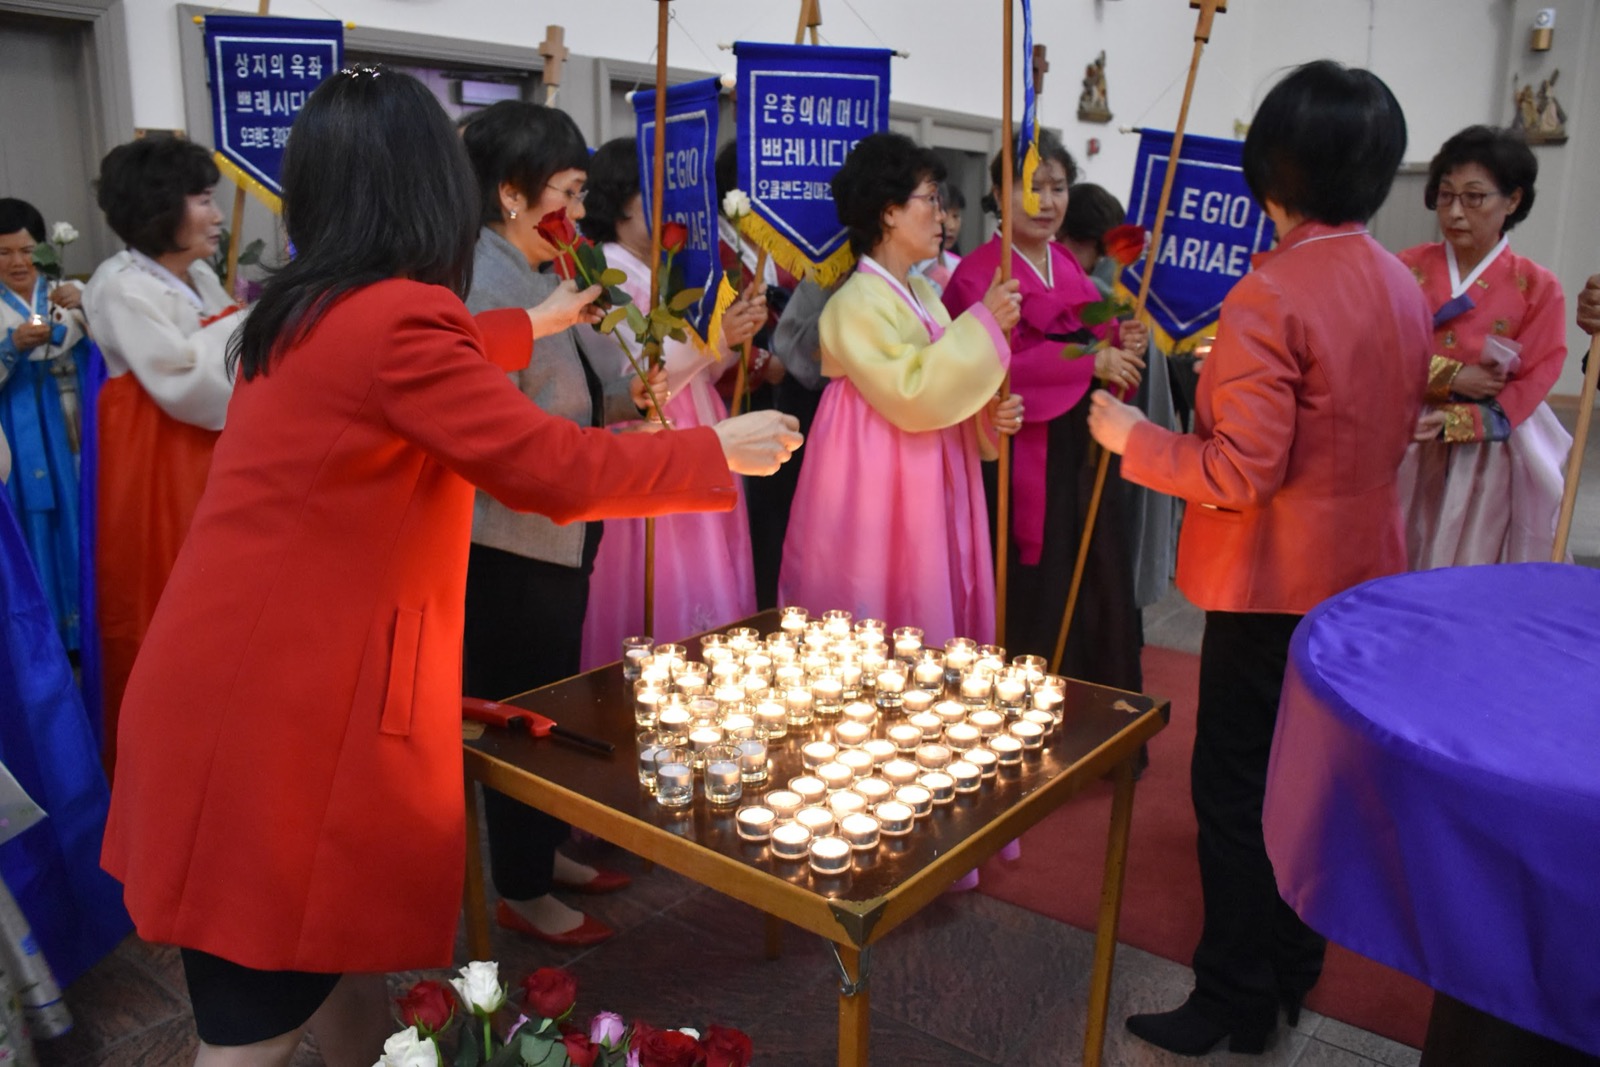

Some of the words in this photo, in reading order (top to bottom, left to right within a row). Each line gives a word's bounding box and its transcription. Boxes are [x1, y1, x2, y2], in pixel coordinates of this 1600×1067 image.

[236, 90, 315, 116] 쁘레시디
[761, 138, 860, 166] 쁘레시디
[653, 147, 699, 191] EGIO
